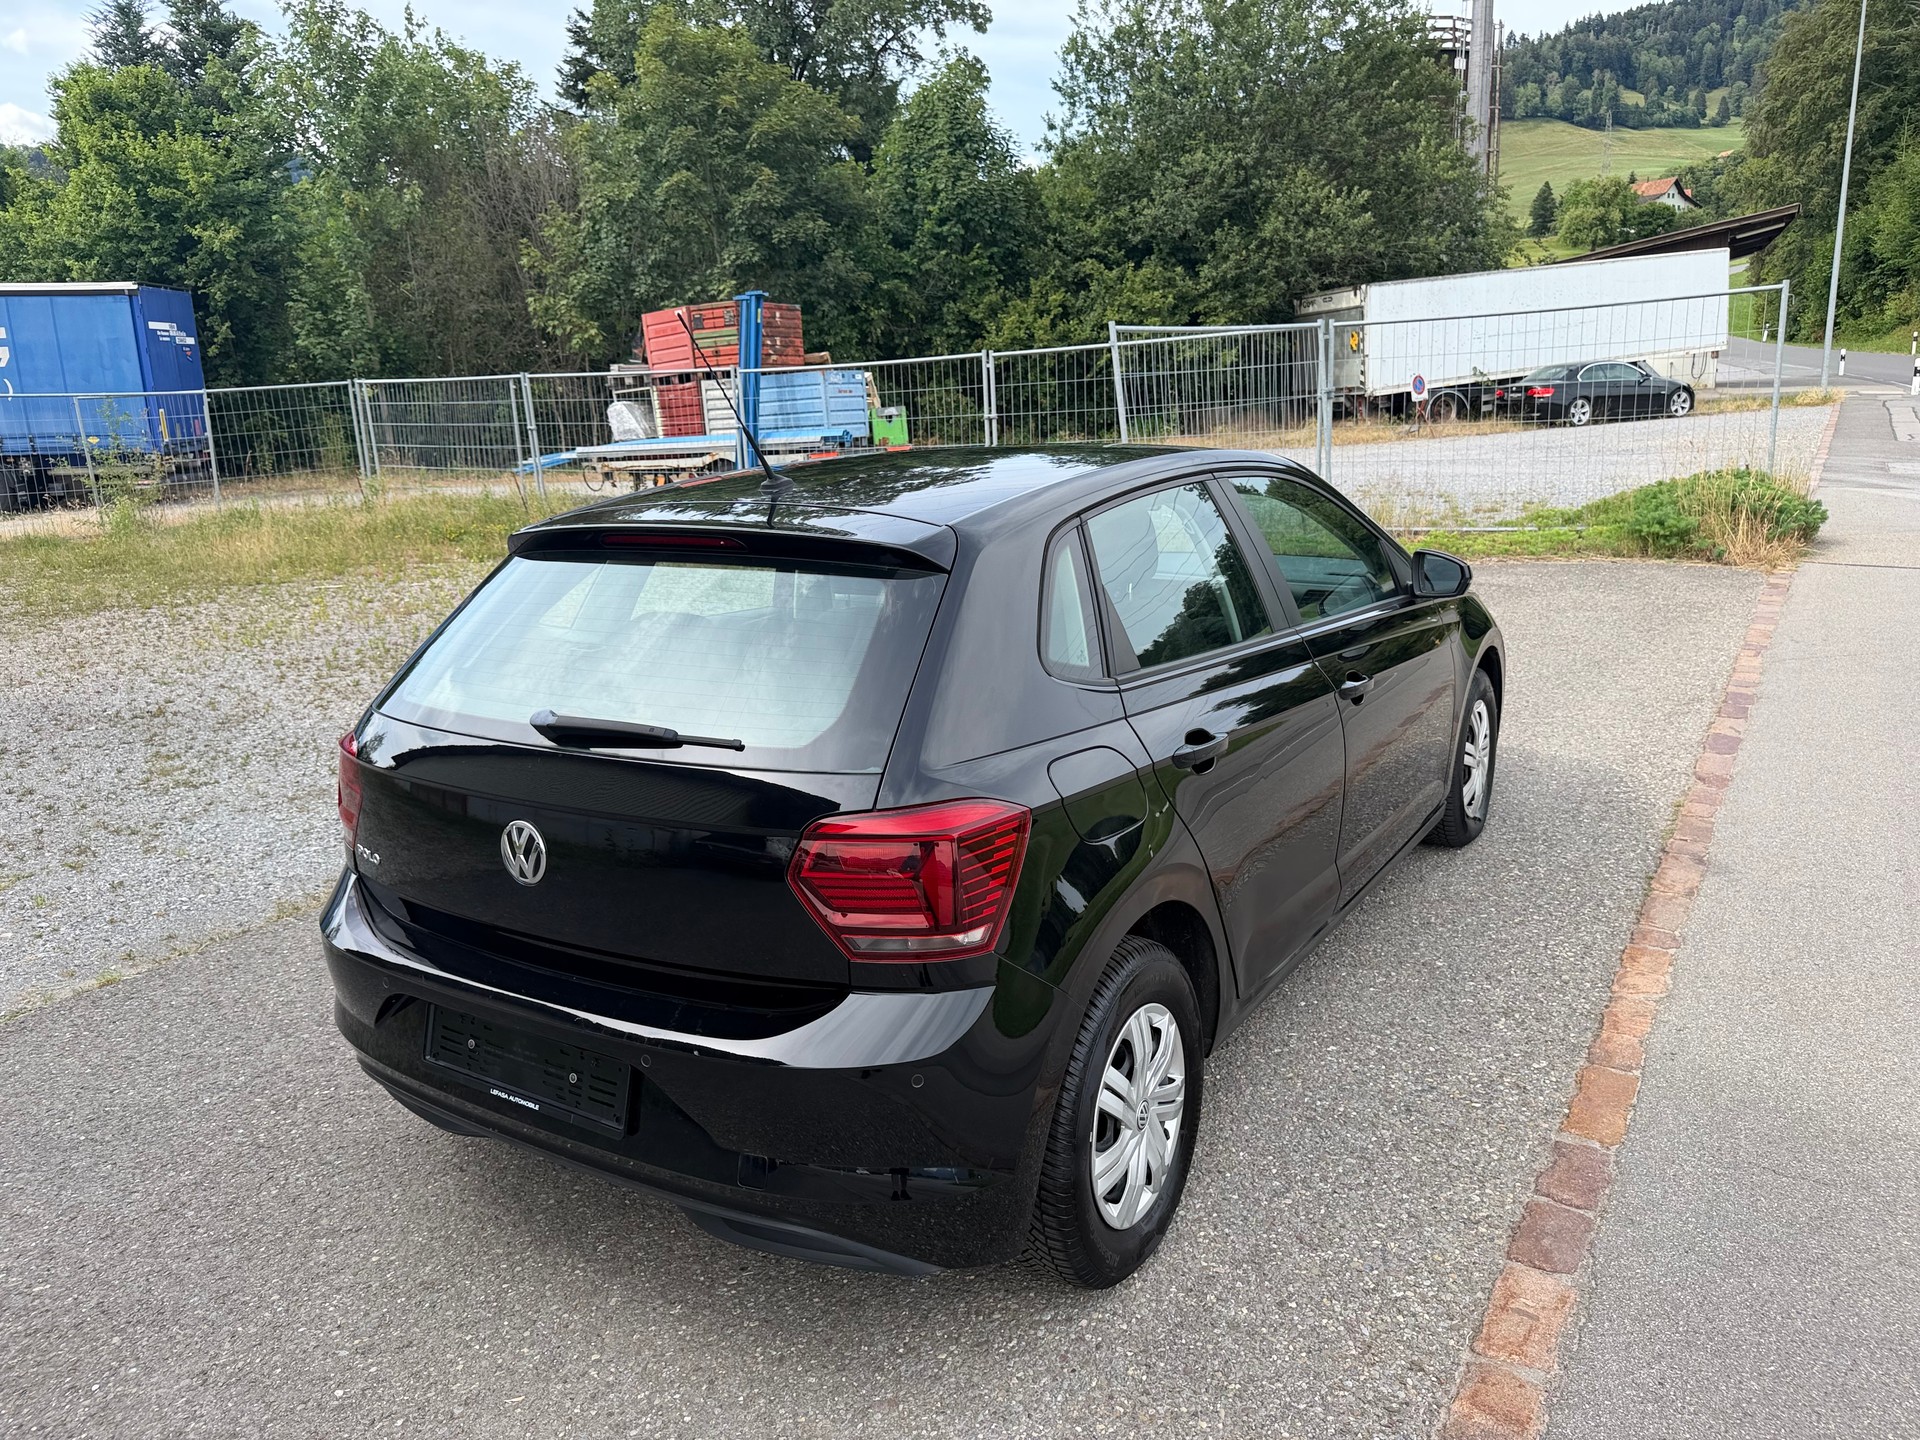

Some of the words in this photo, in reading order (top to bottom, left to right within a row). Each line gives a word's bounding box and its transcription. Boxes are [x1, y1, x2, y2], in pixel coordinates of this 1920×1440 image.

[356, 843, 380, 866] POLO
[490, 1088, 509, 1100] LEFASA
[508, 1095, 540, 1111] AUTOMOBILE
